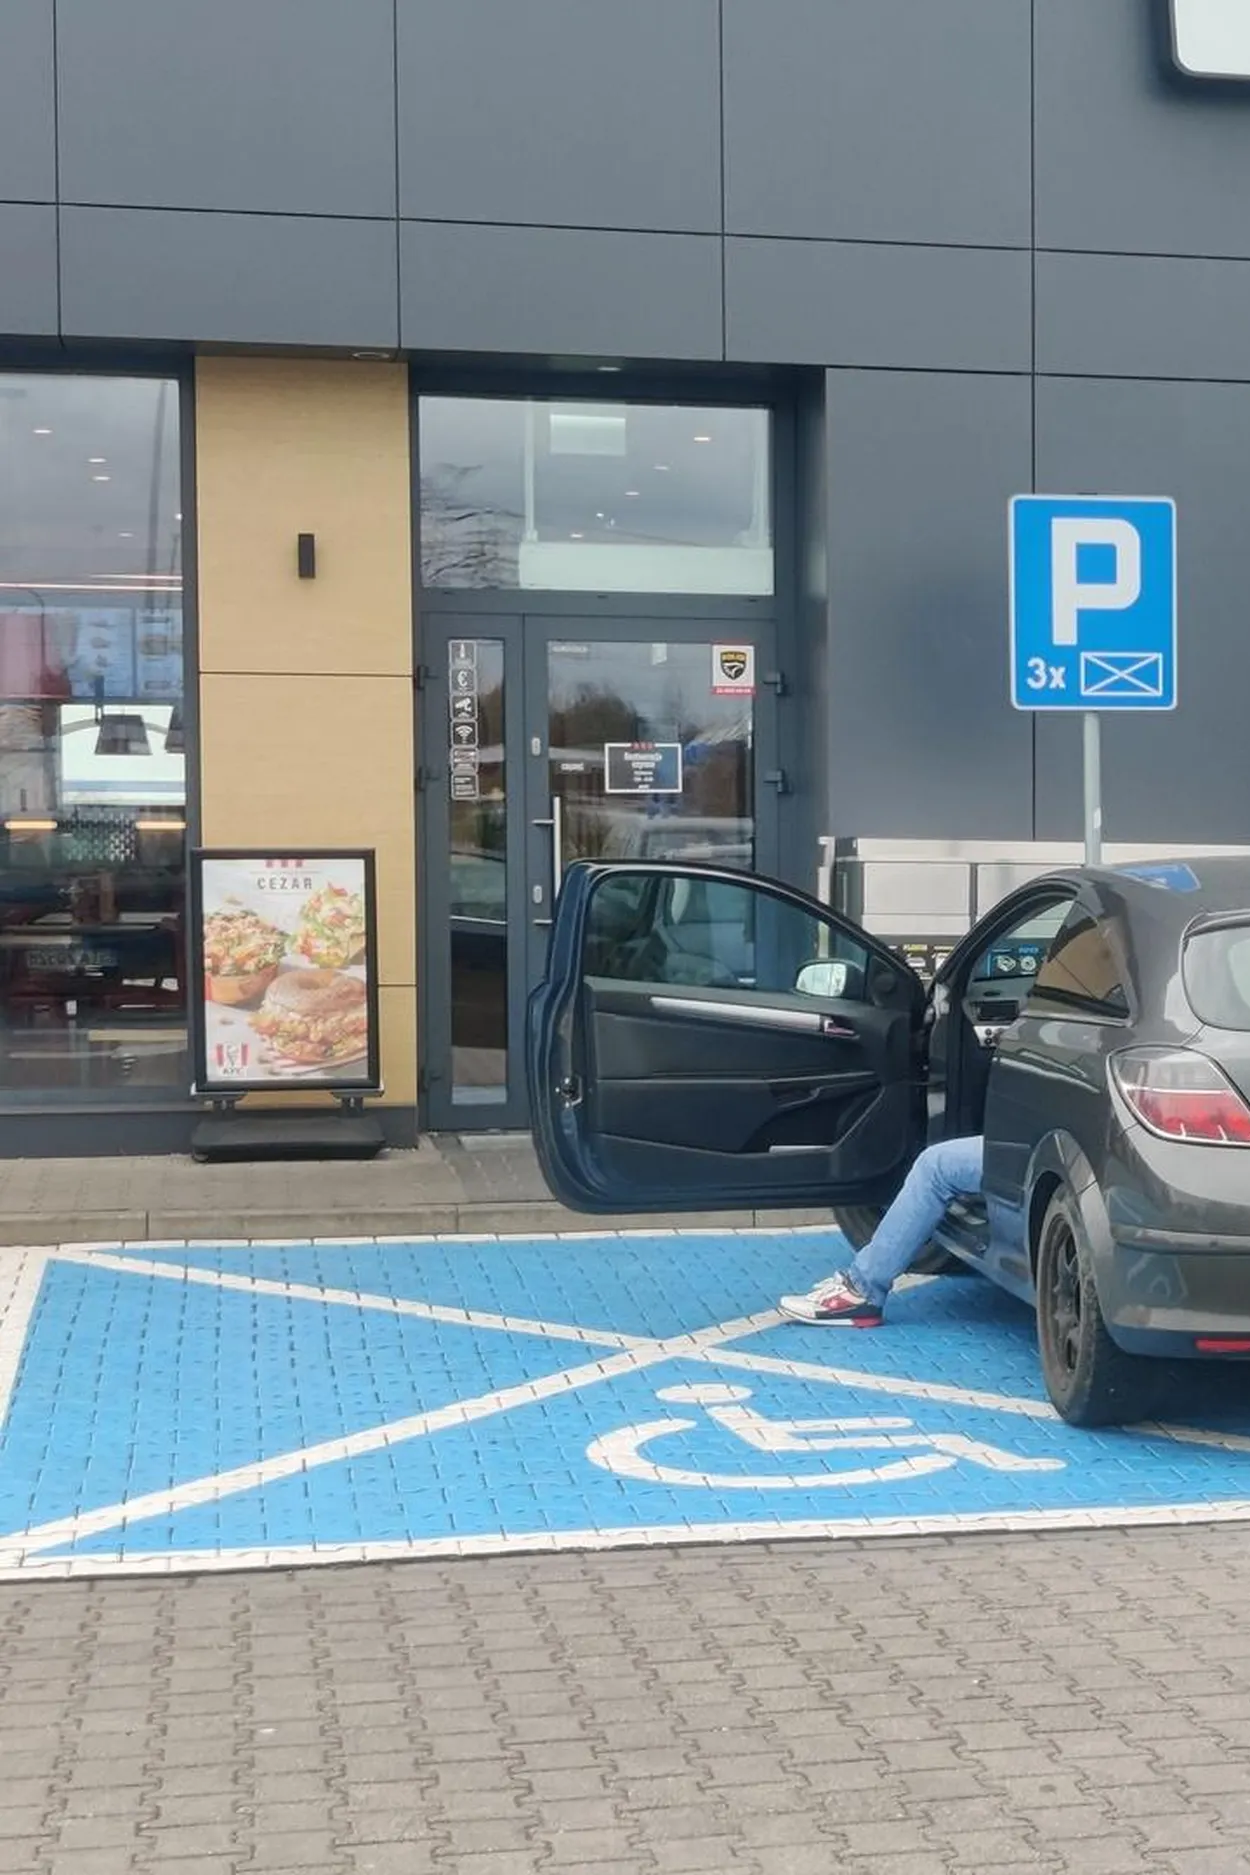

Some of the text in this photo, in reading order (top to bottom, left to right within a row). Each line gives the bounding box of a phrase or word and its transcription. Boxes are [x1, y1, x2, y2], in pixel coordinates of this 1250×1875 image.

[1052, 517, 1141, 645] P
[1026, 656, 1066, 689] 3x
[257, 877, 312, 890] CEZAR
